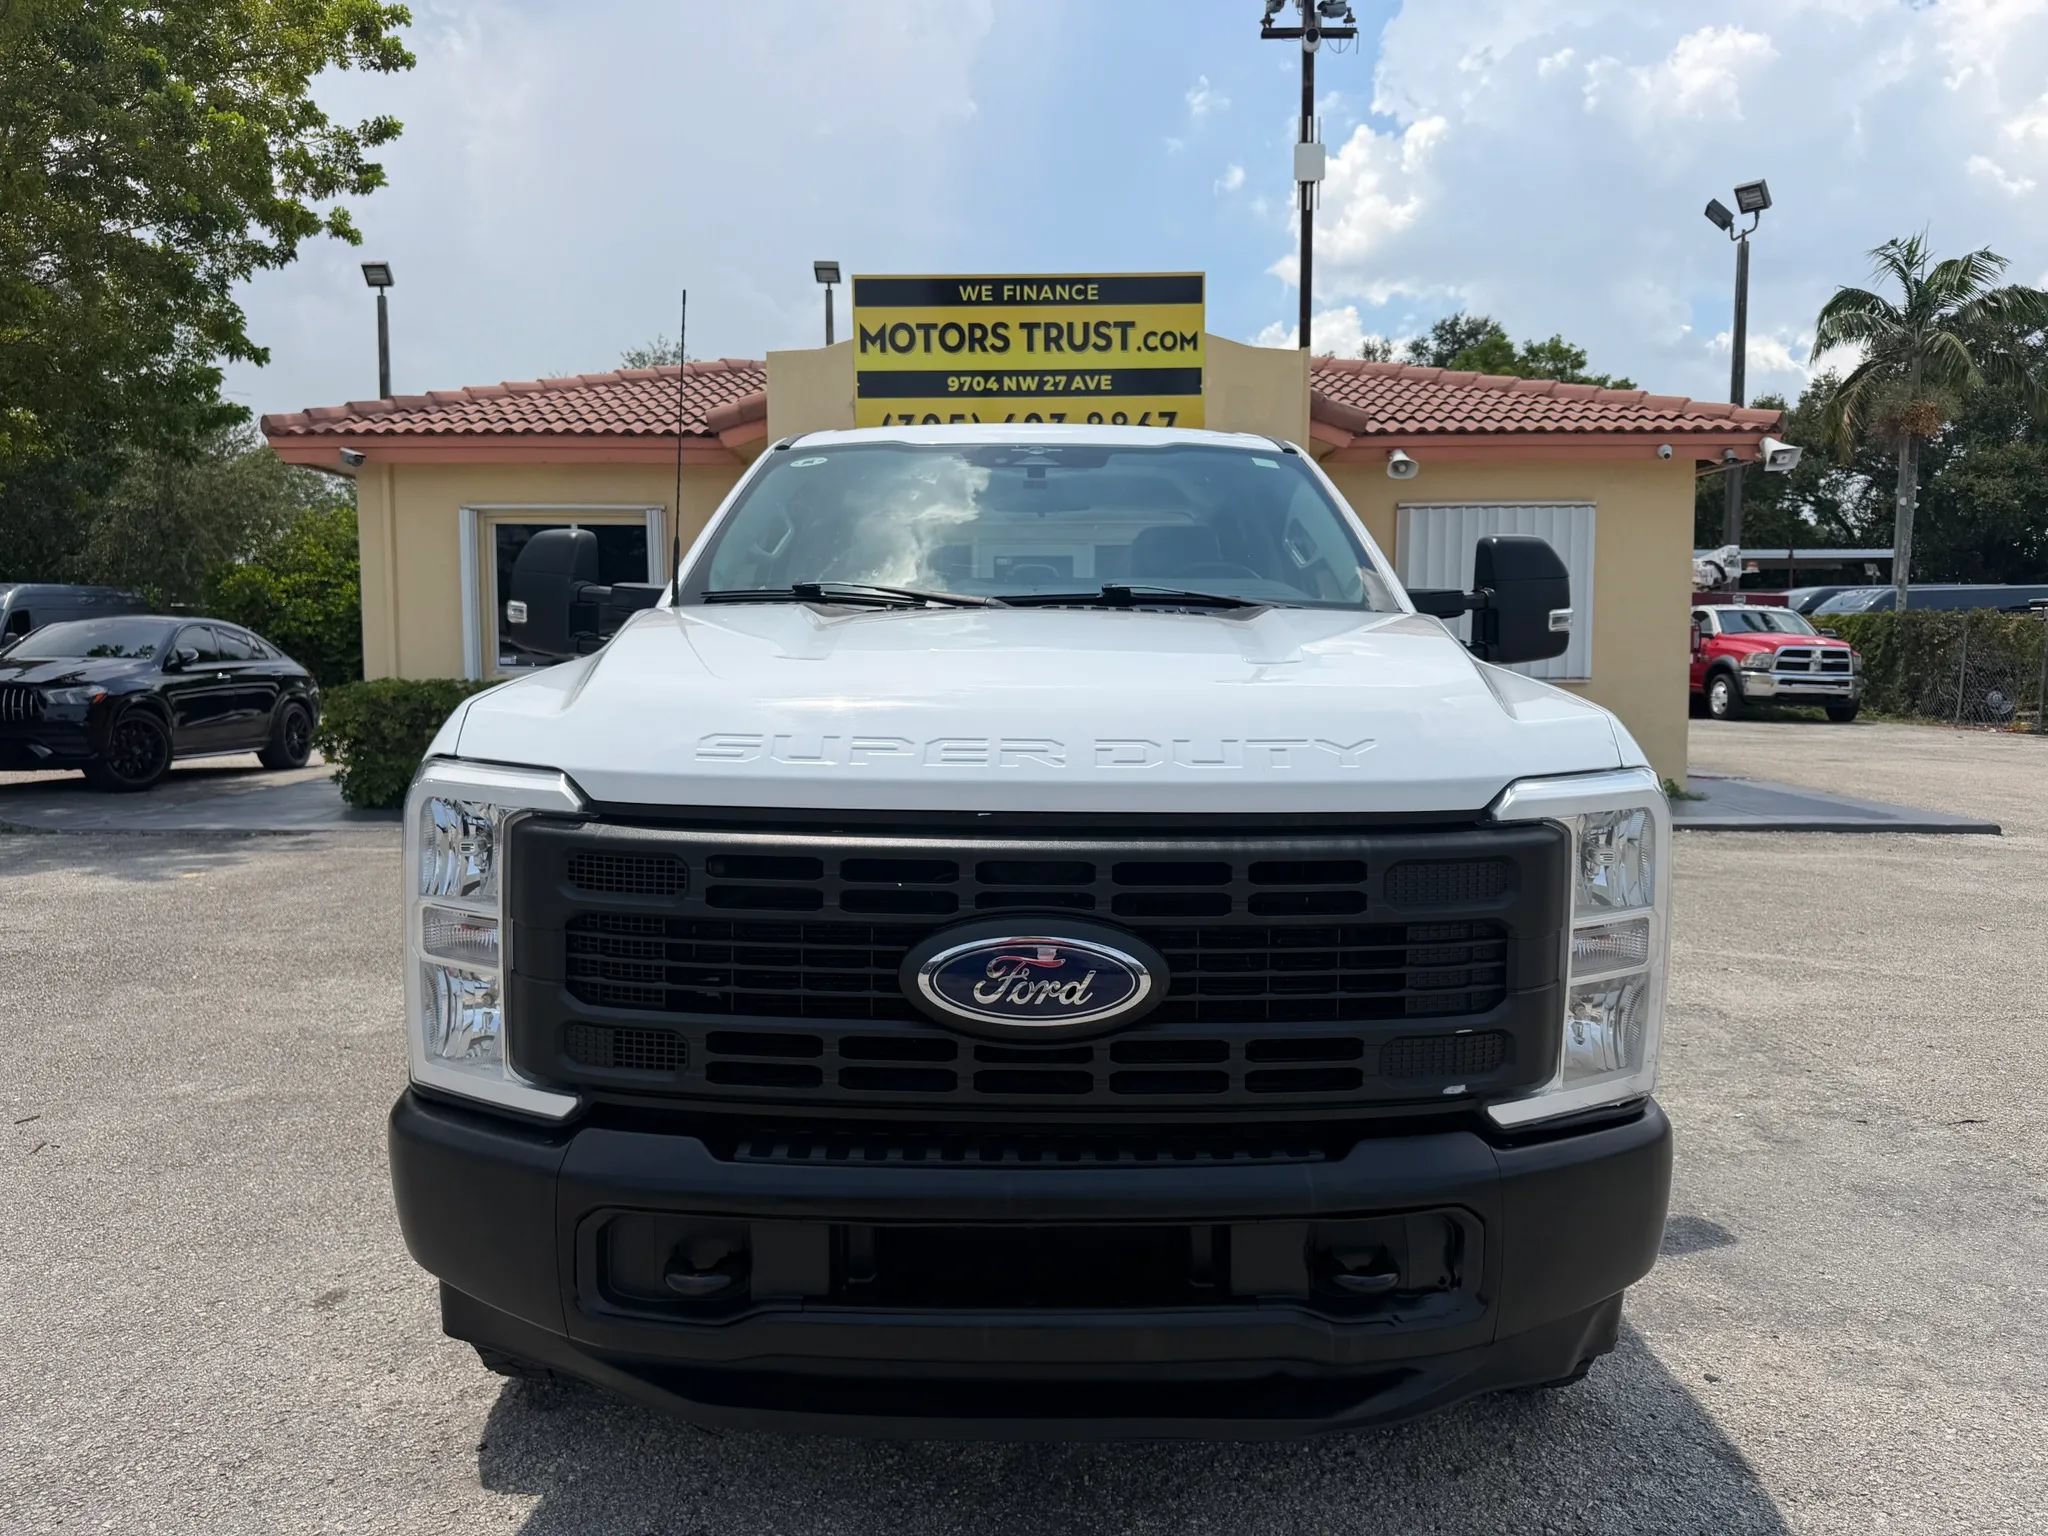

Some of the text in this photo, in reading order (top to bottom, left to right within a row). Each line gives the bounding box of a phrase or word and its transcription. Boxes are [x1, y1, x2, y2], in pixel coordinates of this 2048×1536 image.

[959, 284, 1100, 301] WE FINANCE
[859, 320, 1199, 354] MOTORS TRUST.COM
[947, 375, 1112, 392] 9704 NW 27 AVE
[695, 733, 1378, 768] SUPER DUTY
[973, 955, 1097, 1006] Ford
